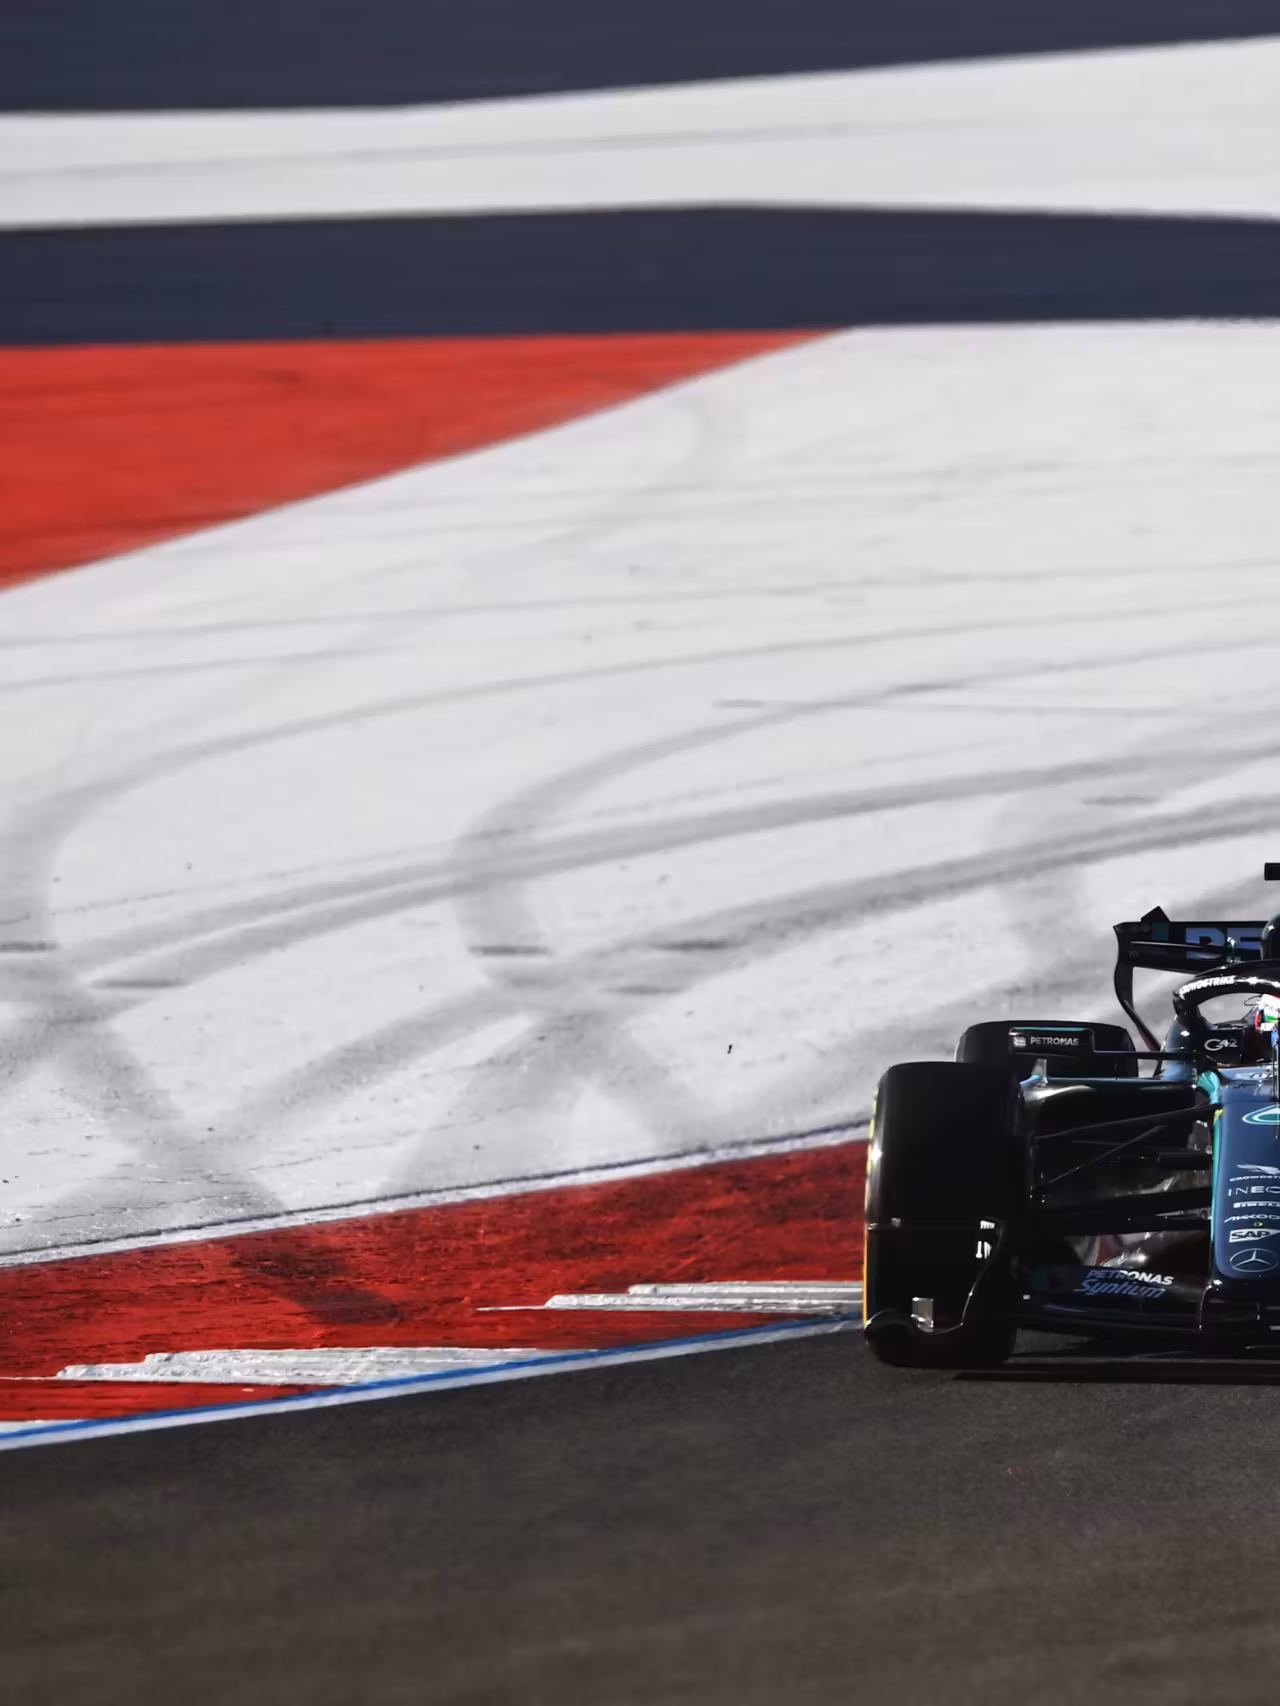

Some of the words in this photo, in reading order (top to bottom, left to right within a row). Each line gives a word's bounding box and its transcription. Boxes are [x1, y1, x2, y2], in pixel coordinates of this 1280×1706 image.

[1030, 1036, 1080, 1046] PETRONAS
[1204, 1038, 1238, 1051] G42
[1086, 1269, 1175, 1286] PETRONAS
[1081, 1279, 1166, 1298] Syntium
